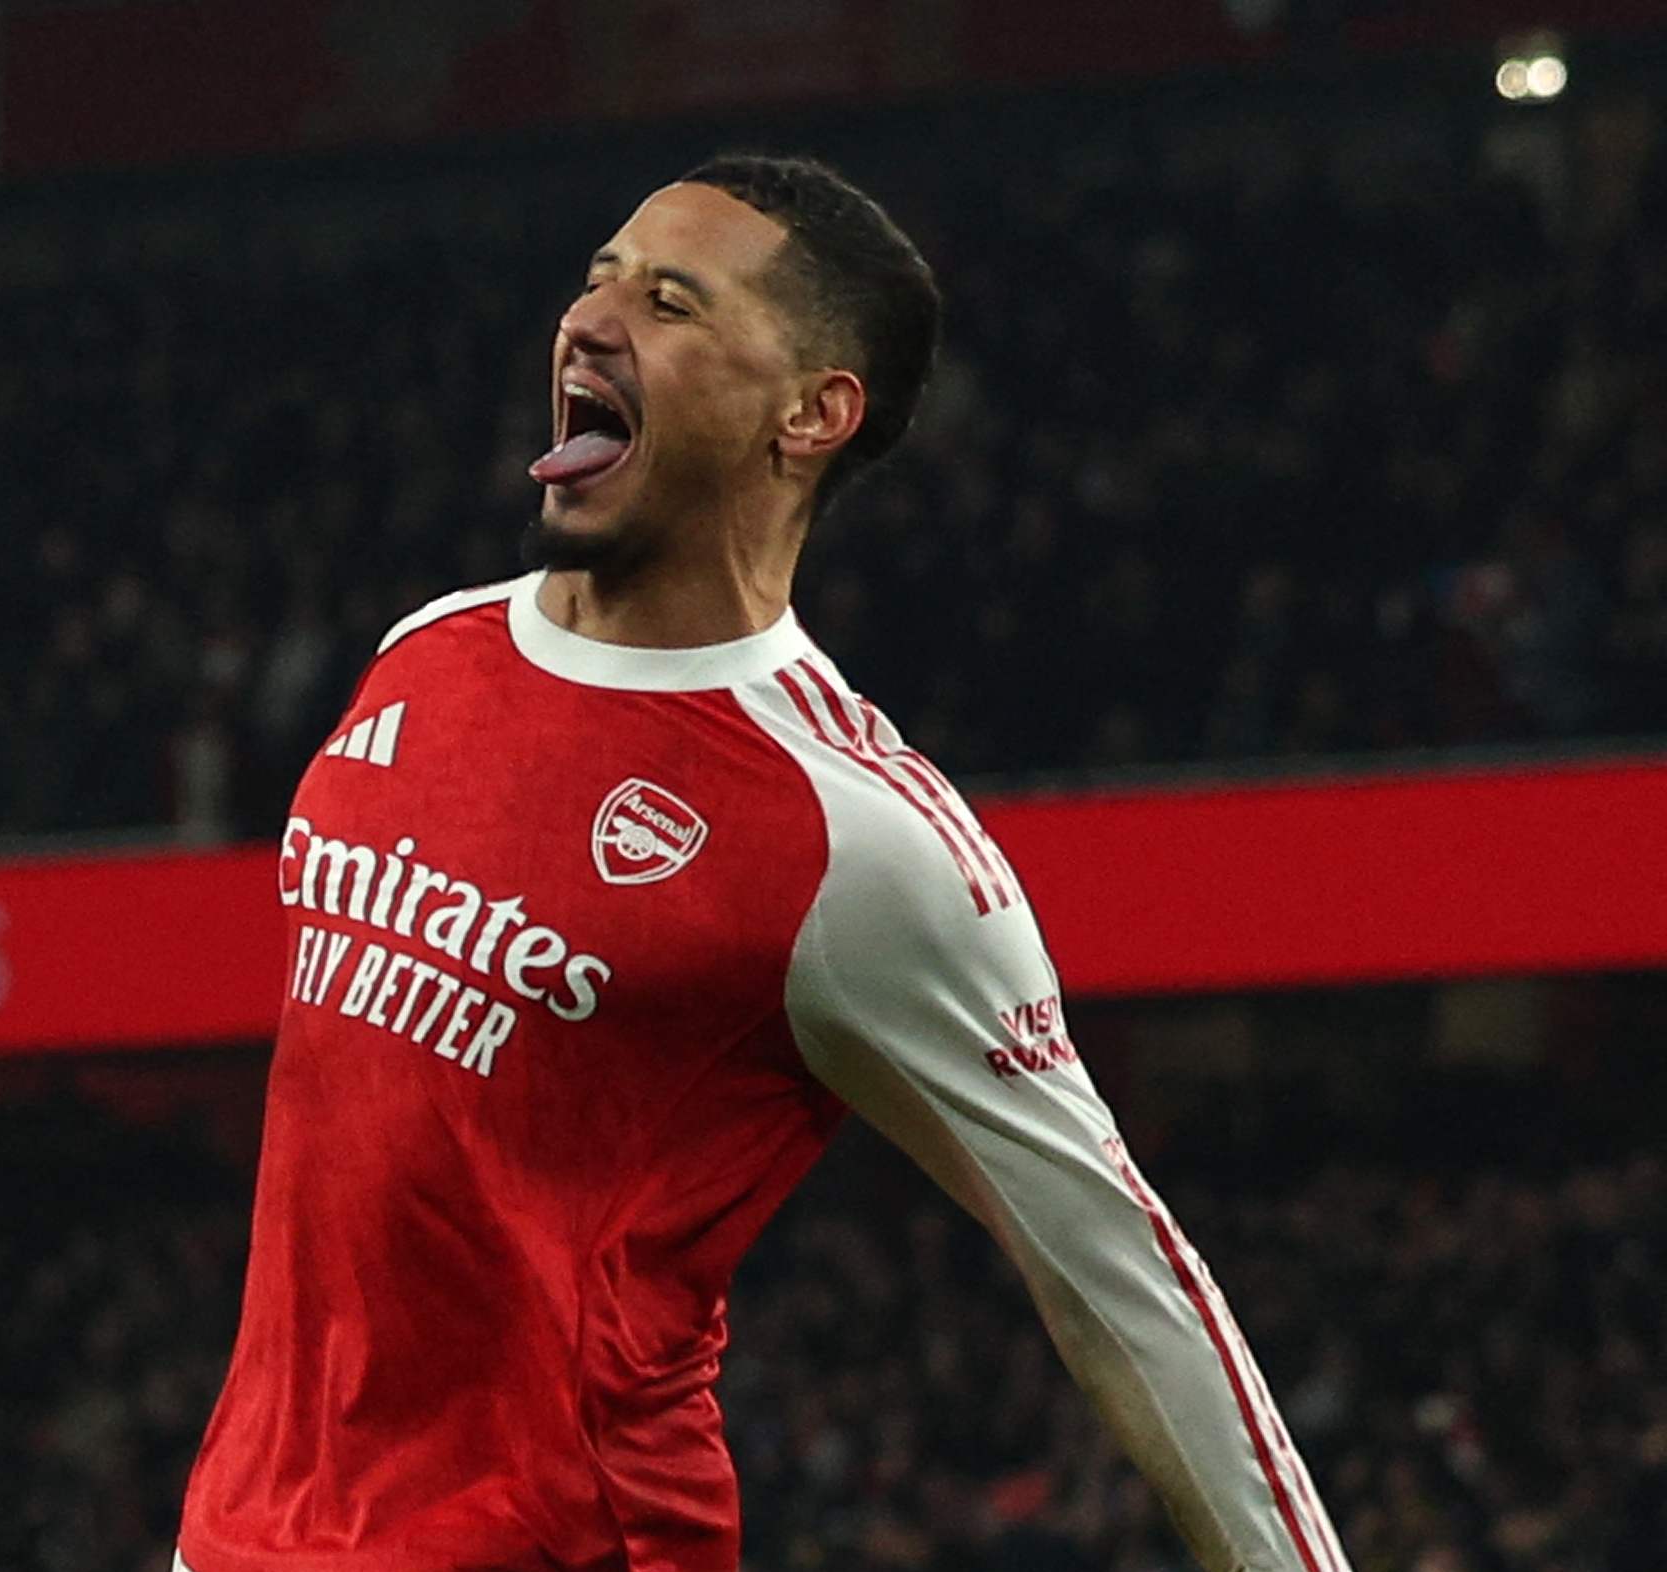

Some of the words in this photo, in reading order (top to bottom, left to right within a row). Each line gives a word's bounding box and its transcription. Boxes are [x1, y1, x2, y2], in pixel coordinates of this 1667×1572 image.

[622, 793, 693, 843] Arsenal
[279, 816, 611, 1022] Emirates
[291, 925, 351, 1006] FLY
[339, 943, 517, 1078] BETTER
